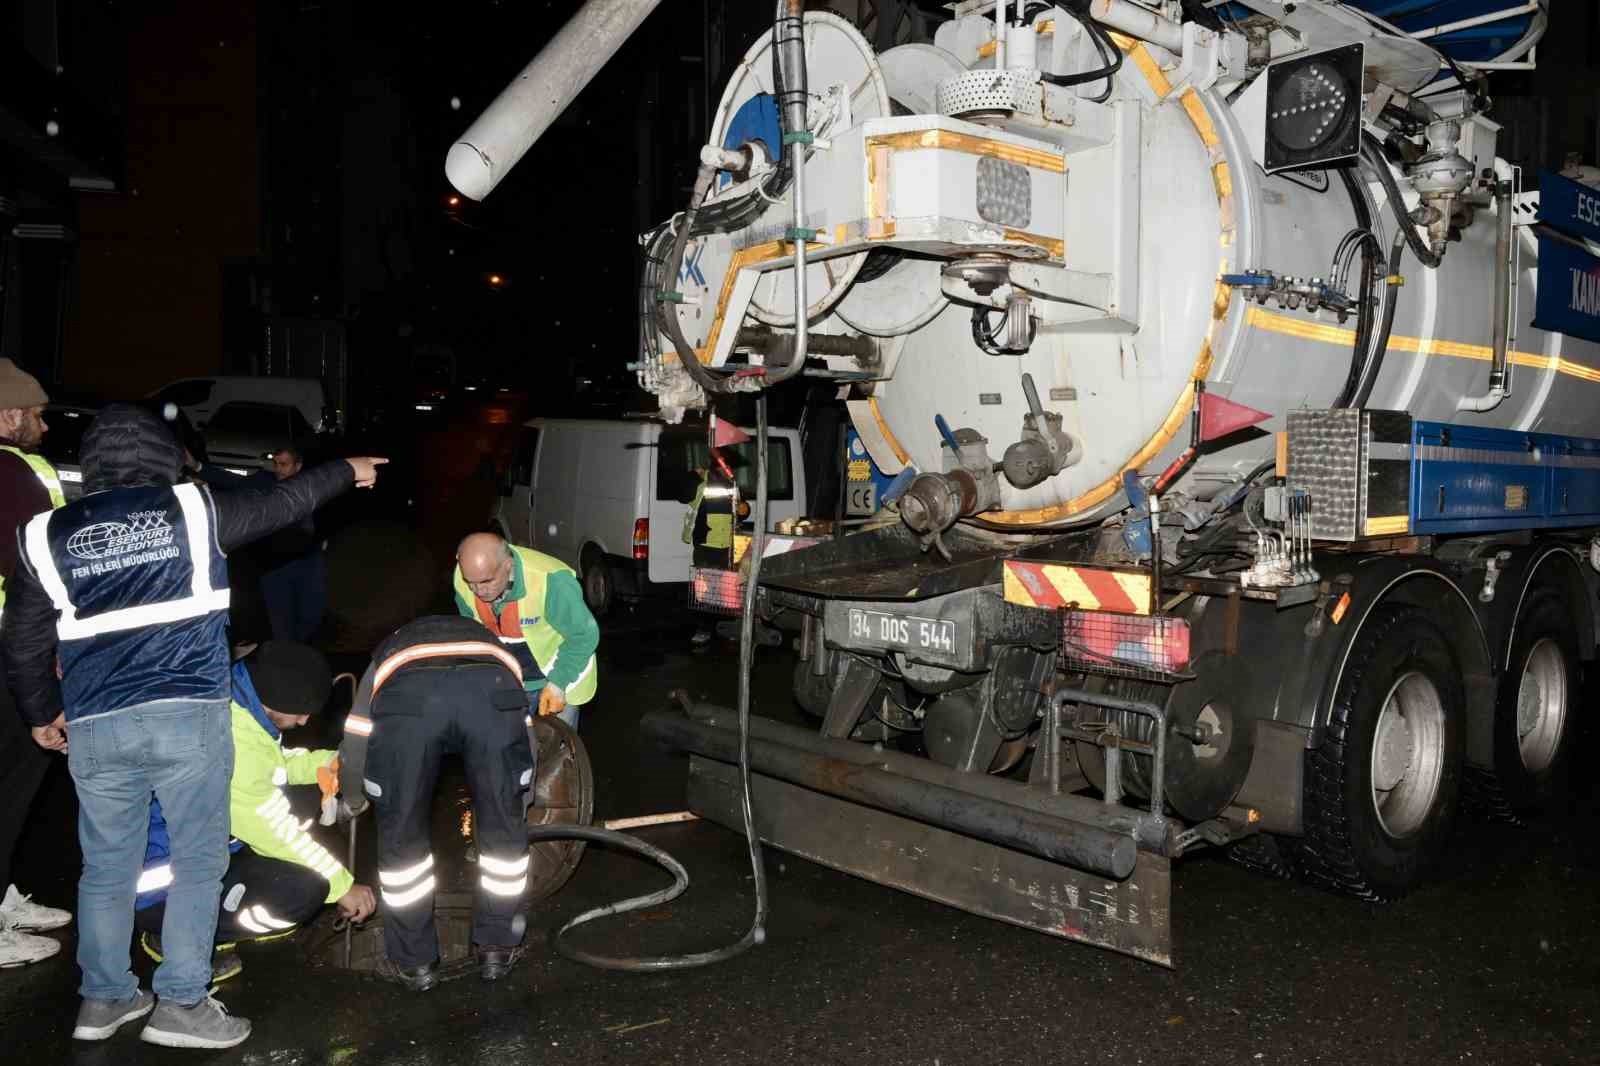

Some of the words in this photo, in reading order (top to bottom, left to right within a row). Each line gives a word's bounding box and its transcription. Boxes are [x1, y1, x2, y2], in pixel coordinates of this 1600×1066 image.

[853, 489, 871, 509] CE
[103, 534, 174, 557] BELEDİYESİ
[107, 529, 170, 548] ESENYURT
[71, 566, 90, 579] FEN
[90, 557, 122, 577] İŞLERİ
[122, 546, 180, 568] MÜDÜRLÜĞÜ
[853, 613, 871, 639] 34
[880, 616, 909, 643] DOS
[919, 622, 951, 651] 544
